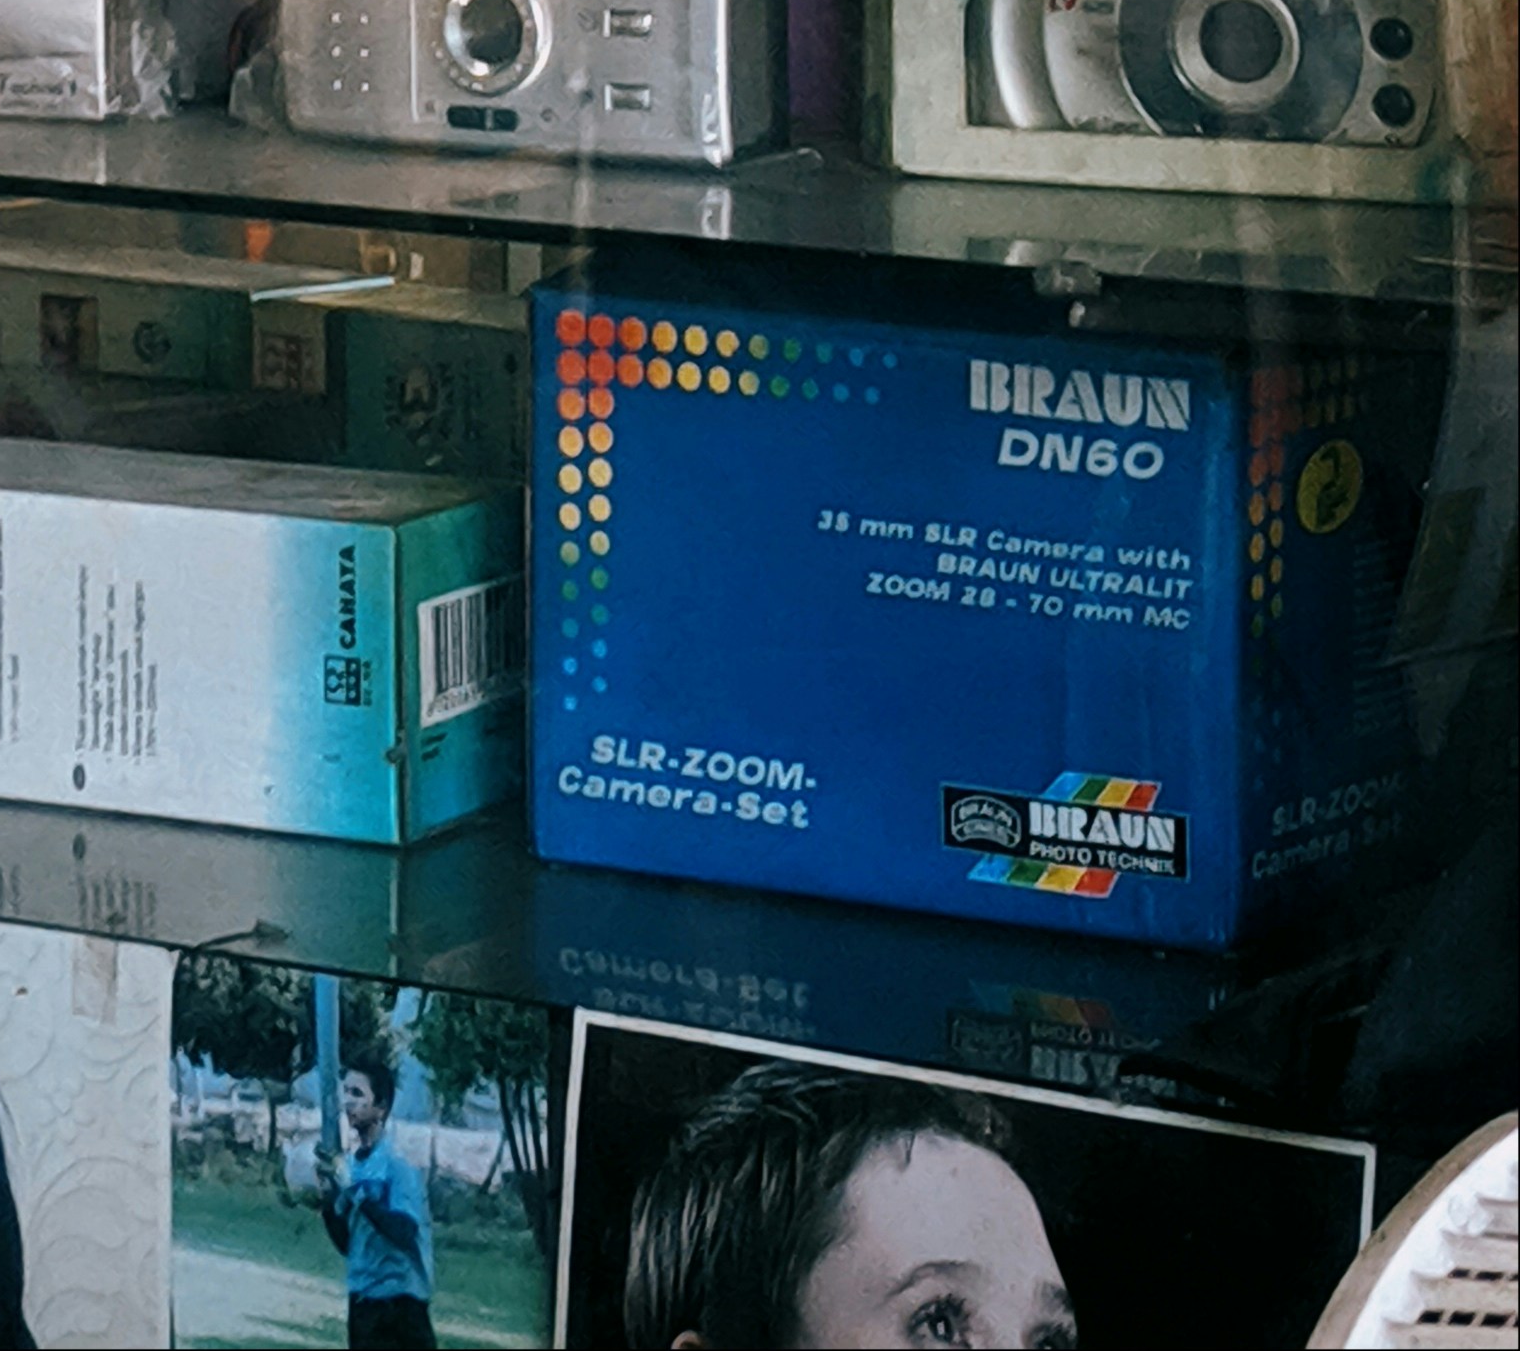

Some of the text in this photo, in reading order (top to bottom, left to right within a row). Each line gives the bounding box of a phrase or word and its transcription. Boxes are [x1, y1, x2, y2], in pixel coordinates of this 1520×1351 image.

[970, 359, 1191, 432] BRAUN
[997, 427, 1165, 481] DN60
[817, 510, 1192, 571] 35 mm SLR Camera with
[339, 545, 357, 650] CAHAYA
[866, 573, 950, 601] ZOOM
[1029, 593, 1064, 616] 70
[1073, 602, 1133, 623] mm
[1143, 606, 1192, 630] MC
[936, 552, 1193, 600] BRAUN ULTRALIT
[590, 734, 817, 791] SLR-ZOOM-
[558, 765, 809, 829] Camera-Set
[1029, 800, 1176, 853] BRAUN
[1029, 839, 1092, 863] PHOTO
